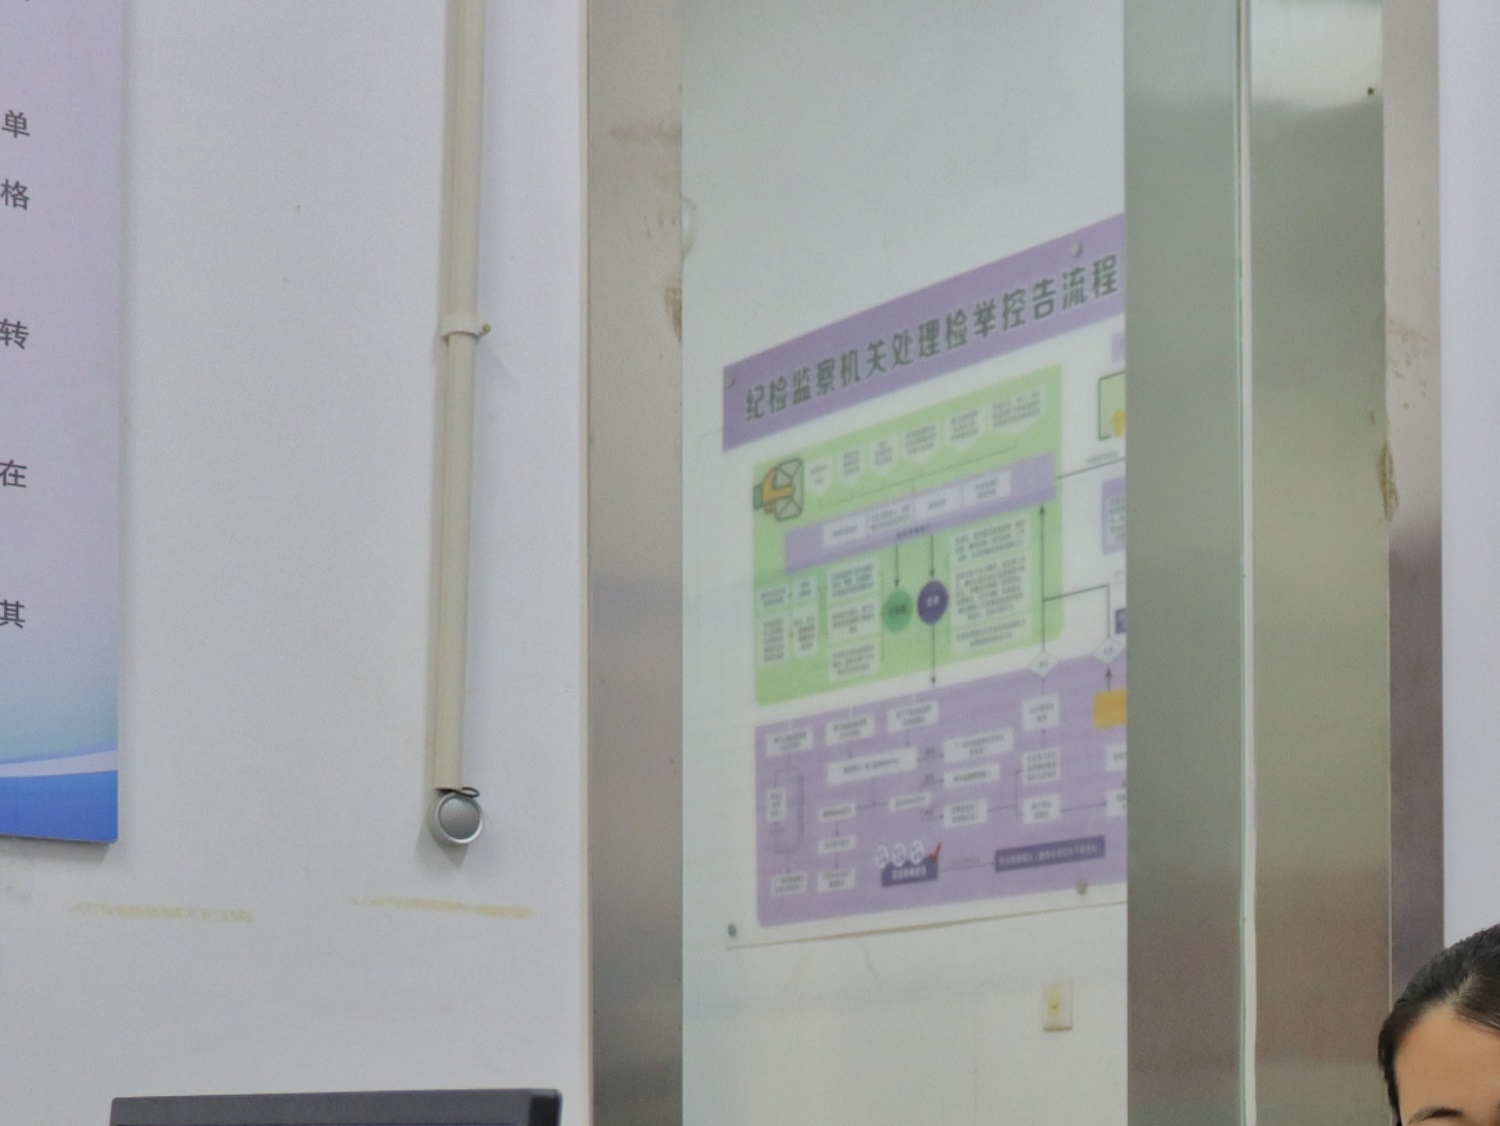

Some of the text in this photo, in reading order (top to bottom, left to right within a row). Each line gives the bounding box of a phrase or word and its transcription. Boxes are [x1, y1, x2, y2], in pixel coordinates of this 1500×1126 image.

[1, 109, 31, 139] 单
[0, 178, 30, 211] 格
[0, 318, 30, 350] 转
[745, 253, 1118, 422] 纪检监察机关处理检举控告流程
[0, 459, 28, 489] 在
[0, 599, 26, 629] 其
